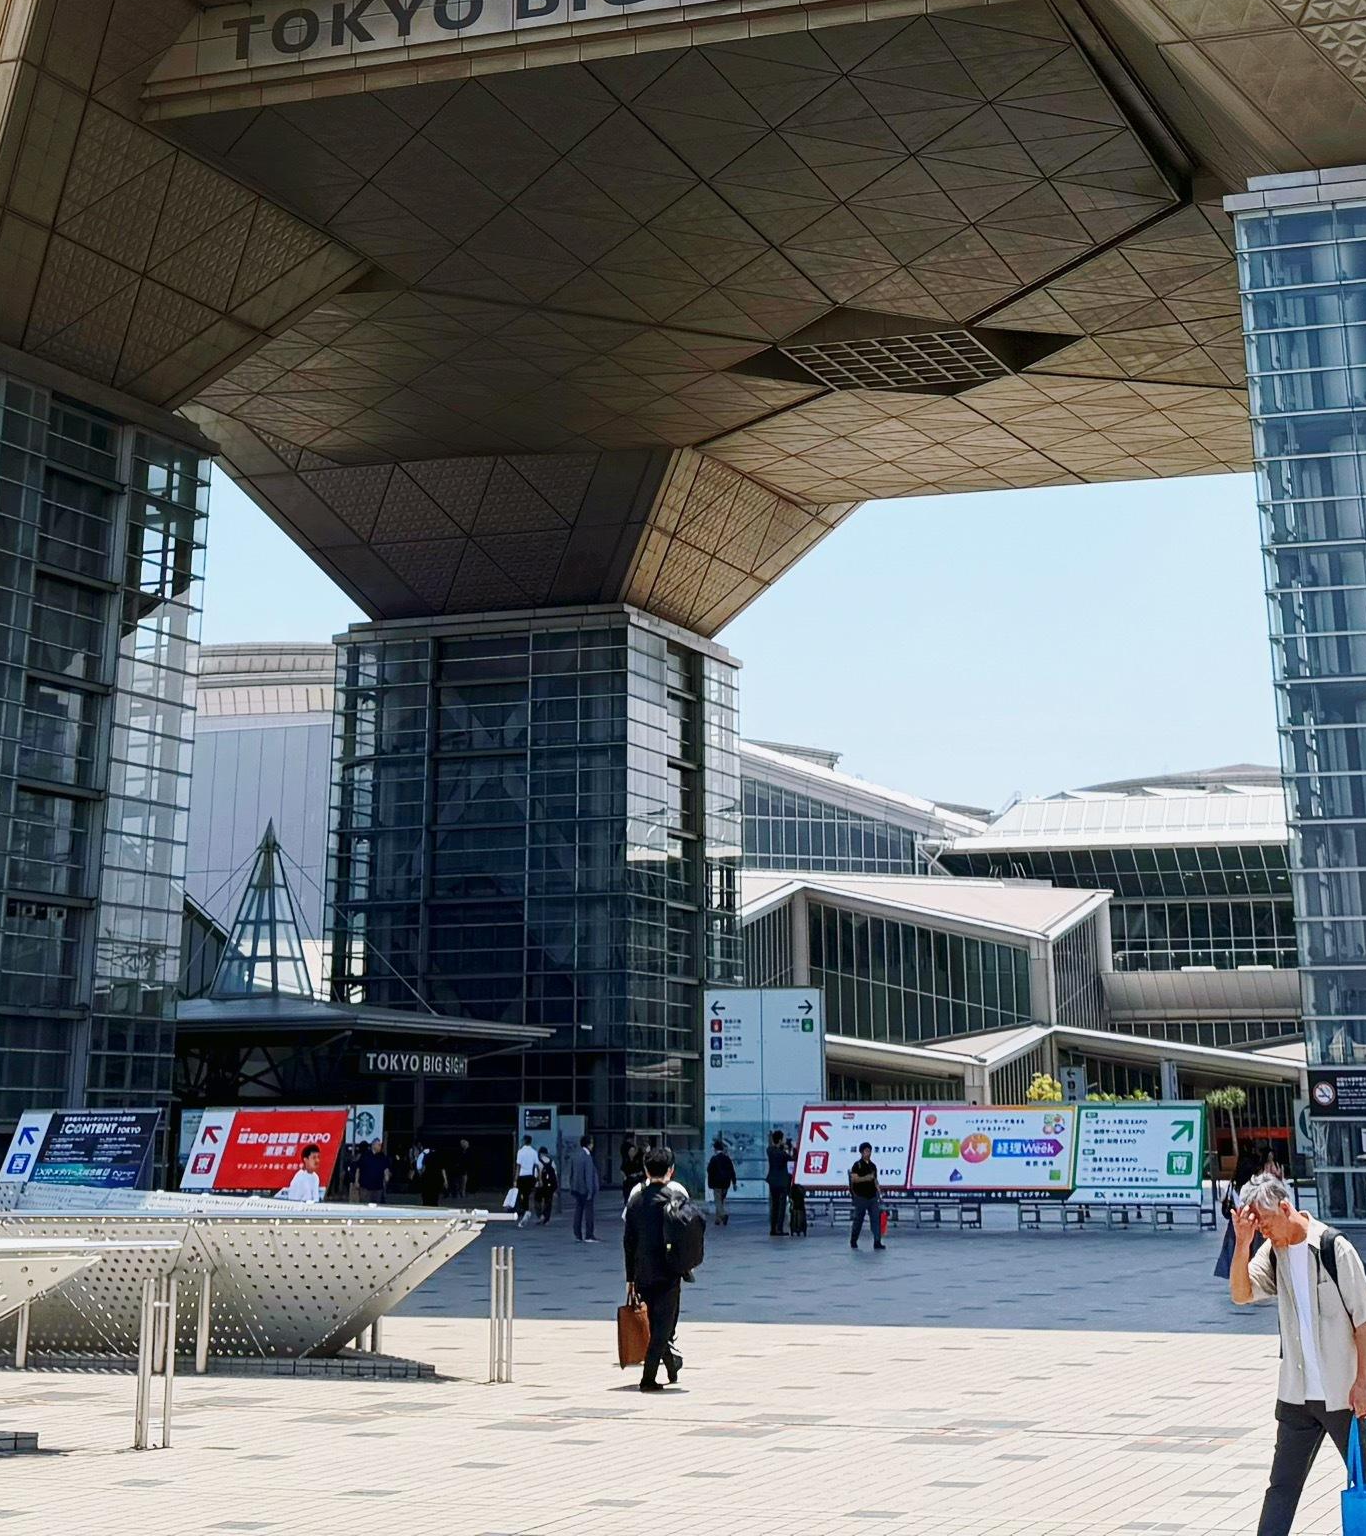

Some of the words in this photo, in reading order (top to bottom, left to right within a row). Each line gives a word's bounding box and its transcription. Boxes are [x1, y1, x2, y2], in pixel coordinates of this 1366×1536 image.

[366, 1052, 420, 1072] TOKYO
[423, 1055, 442, 1073] BIG
[445, 1058, 468, 1075] SIGHT
[64, 1123, 117, 1134] CONTENT
[865, 1123, 887, 1131] EXPO
[300, 1132, 331, 1144] EXPO
[964, 1142, 989, 1155] 人事
